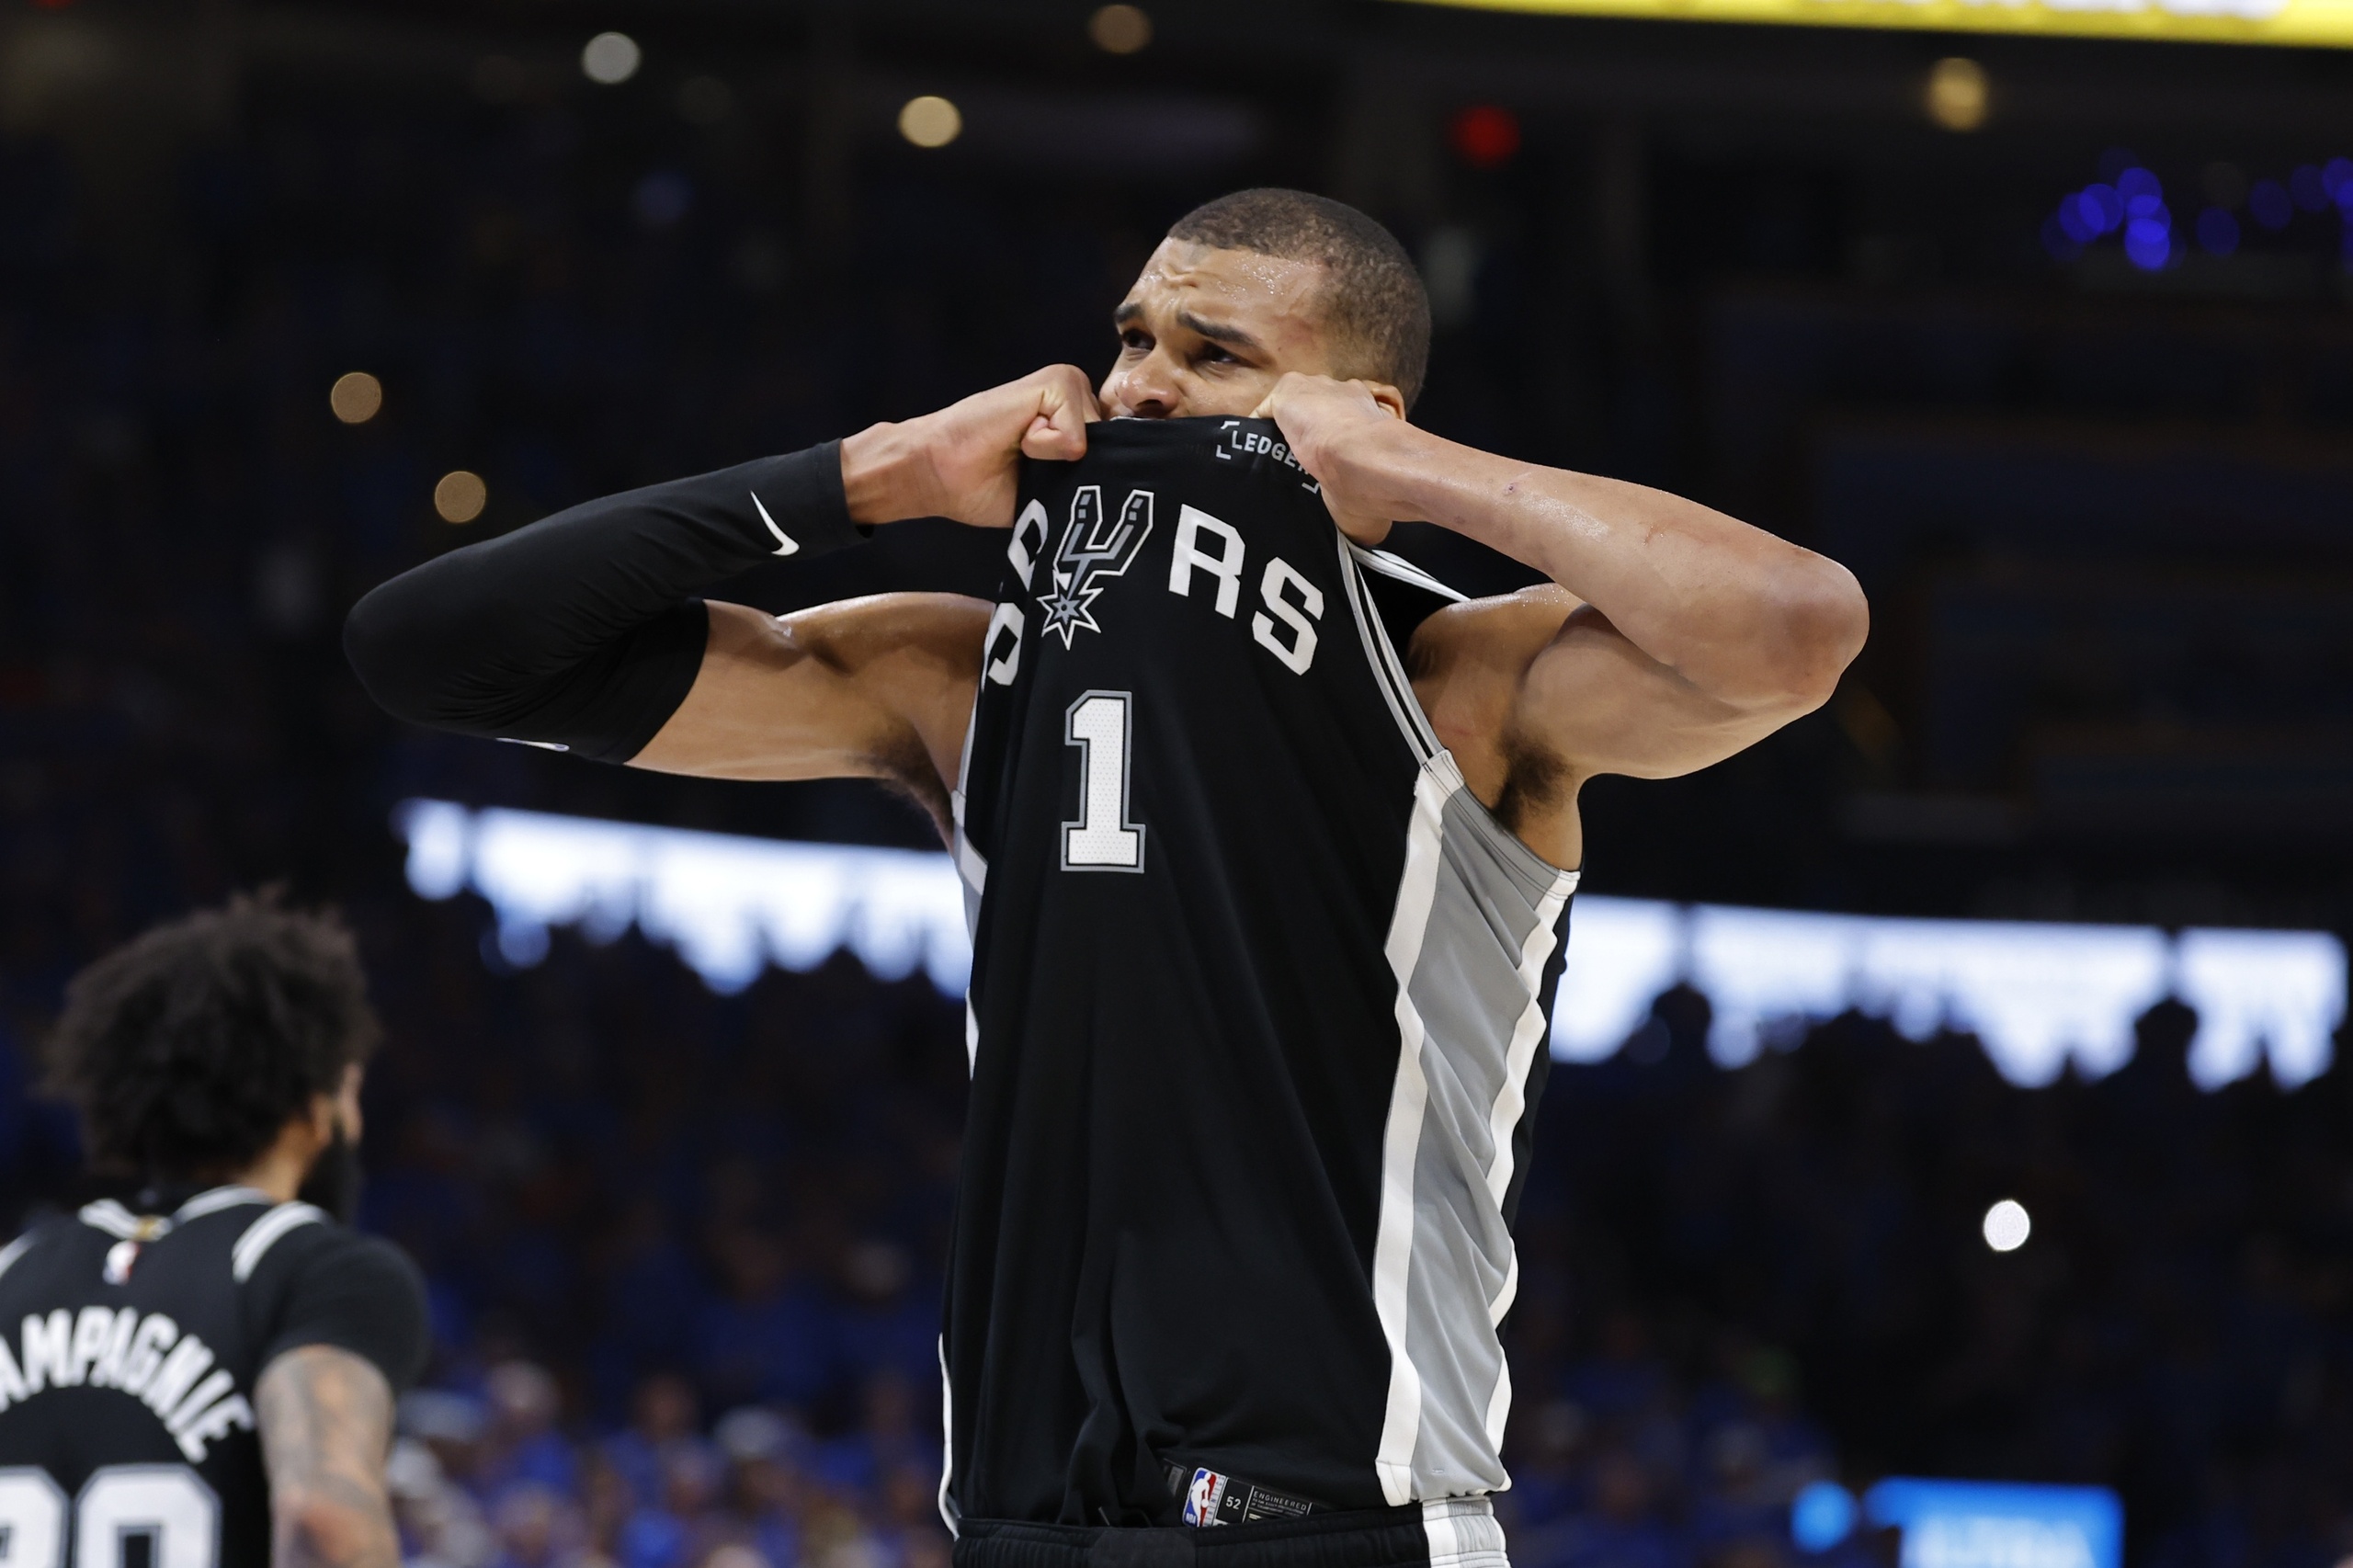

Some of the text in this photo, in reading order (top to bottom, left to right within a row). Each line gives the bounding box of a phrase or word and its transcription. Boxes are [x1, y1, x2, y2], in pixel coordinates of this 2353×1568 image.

[1061, 689, 1146, 874] 1
[1225, 1495, 1241, 1510] 52
[1253, 1491, 1307, 1511] ENGINEERED
